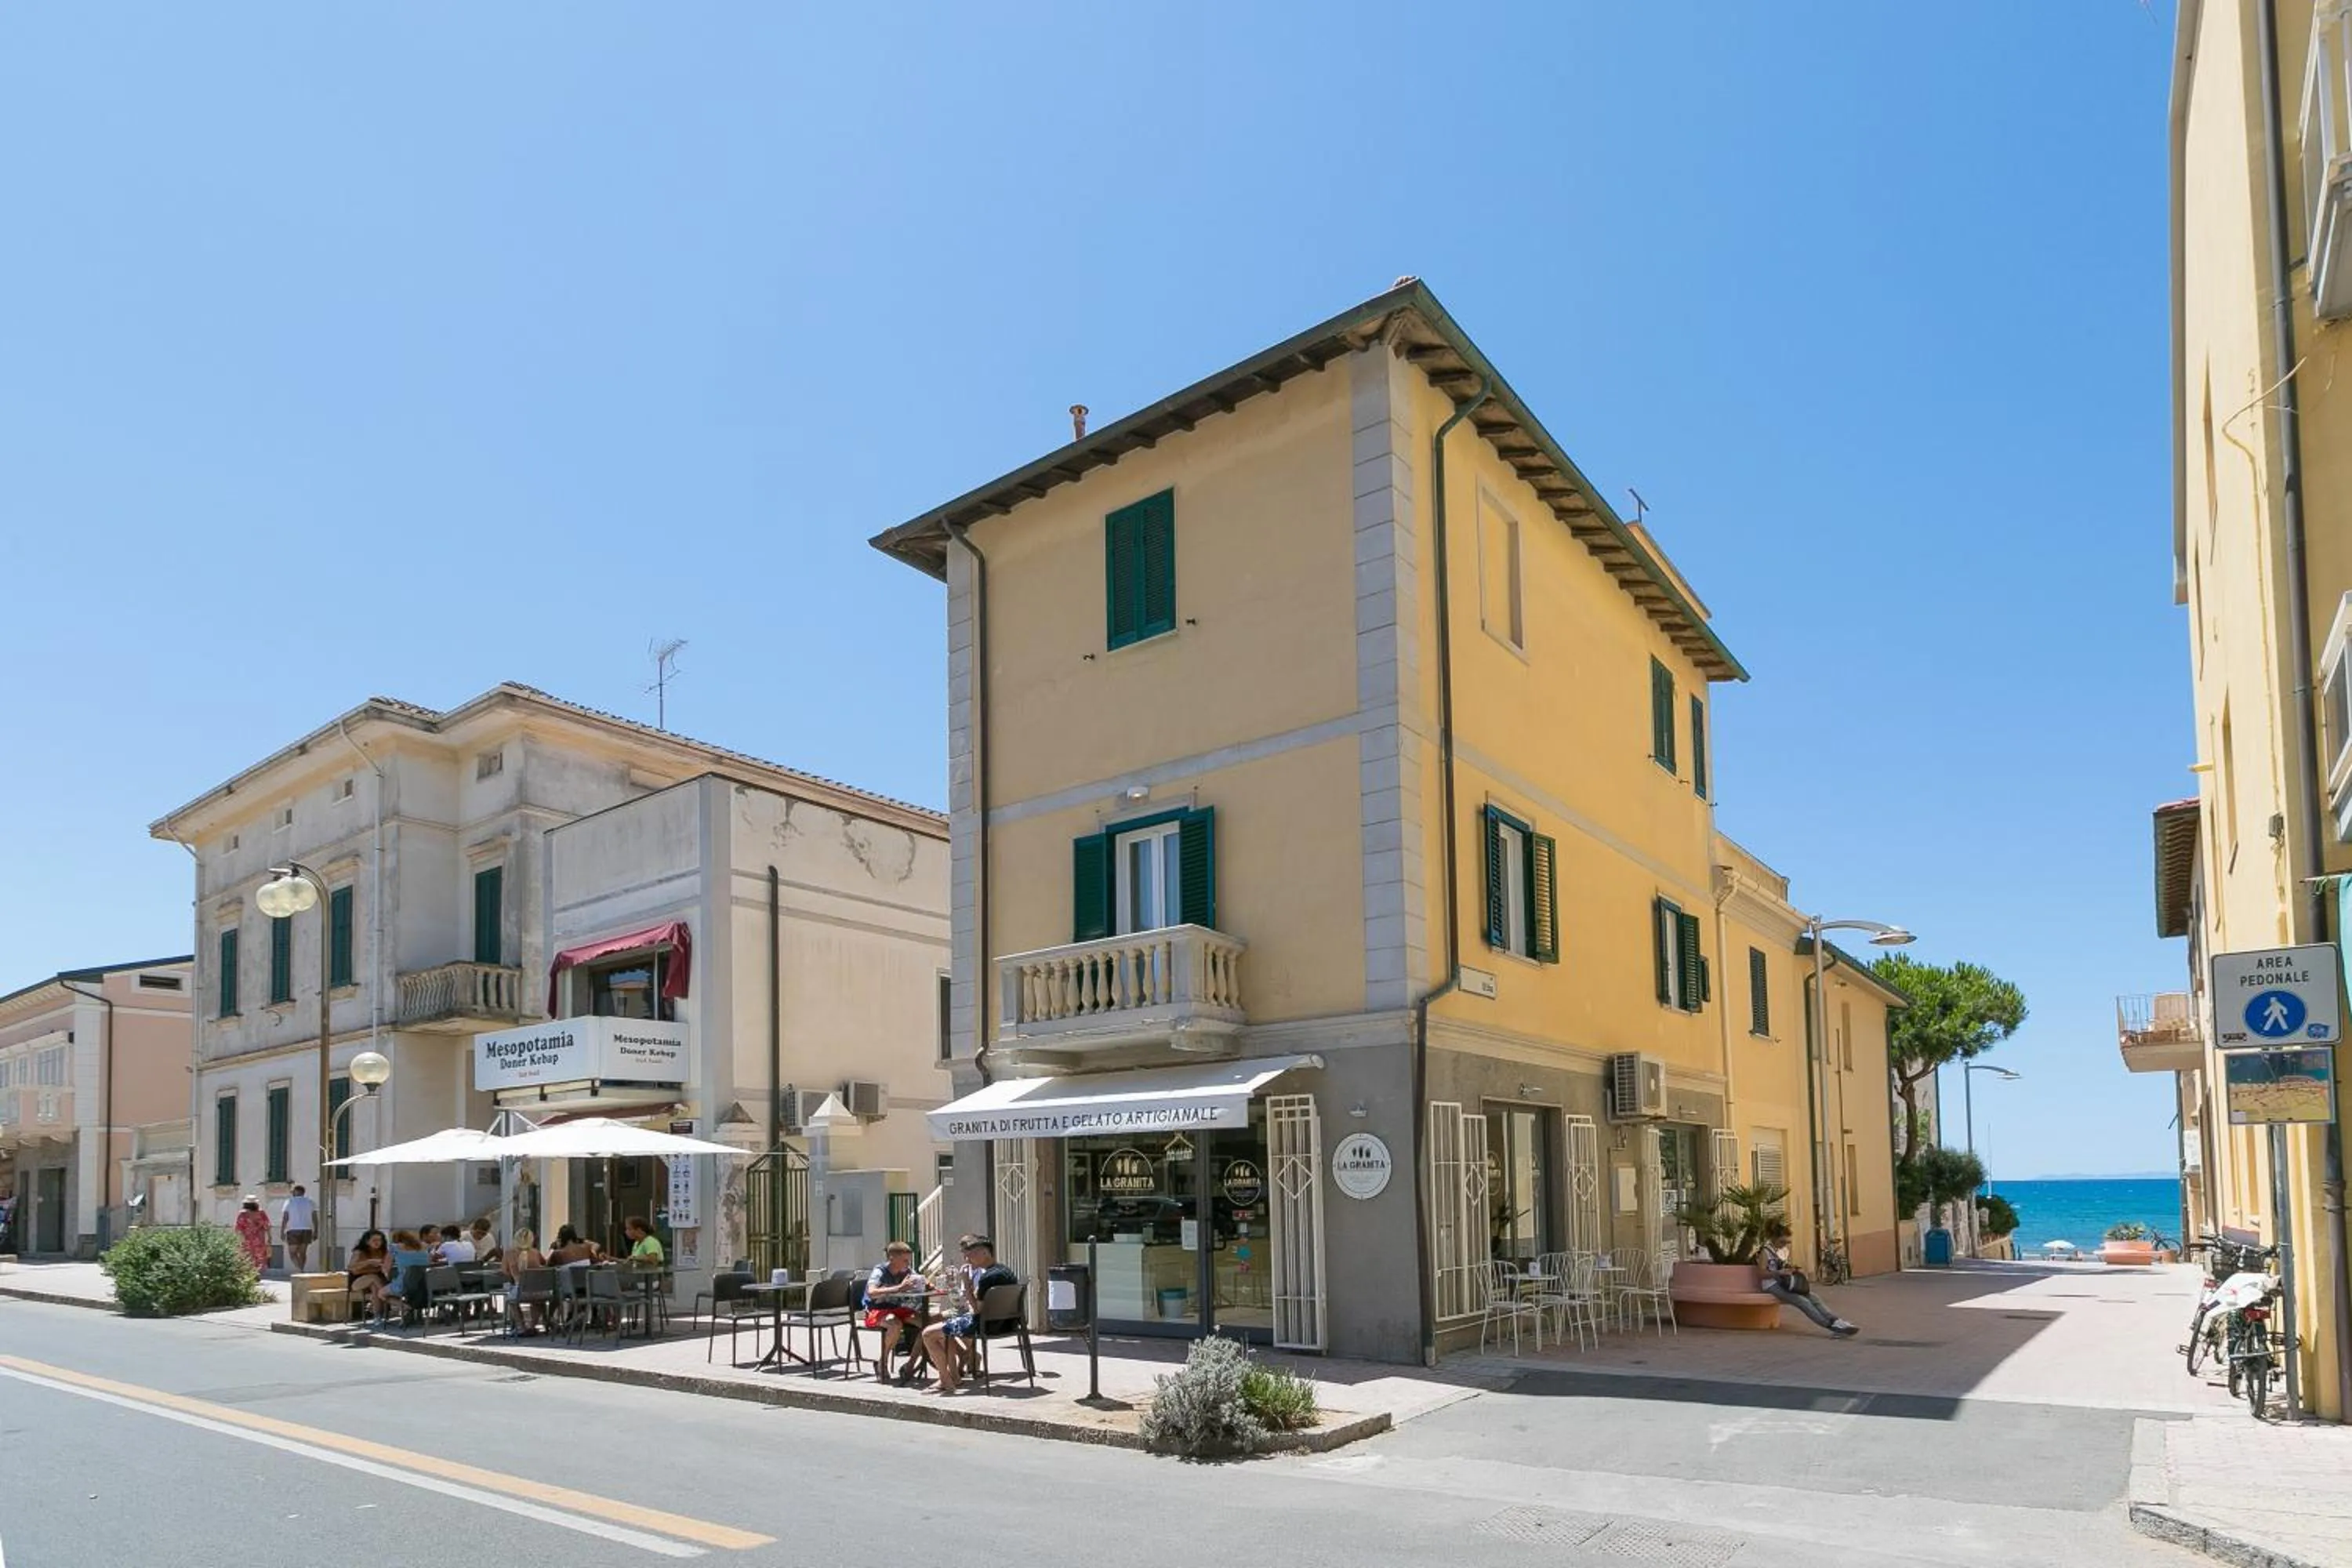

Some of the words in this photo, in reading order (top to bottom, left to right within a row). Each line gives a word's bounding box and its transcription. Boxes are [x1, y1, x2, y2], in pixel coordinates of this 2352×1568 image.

[2256, 956, 2293, 969] AREA
[2240, 971, 2310, 986] PEDONALE
[486, 1031, 574, 1058] Mesopotamia
[614, 1034, 681, 1046] Mesopotamia
[499, 1058, 527, 1069] Doner
[529, 1054, 559, 1066] Kebap
[949, 1120, 998, 1134] GRANITA
[1000, 1119, 1011, 1131] DI
[1012, 1116, 1058, 1131] FRUTTA
[1062, 1116, 1069, 1128] E
[1072, 1112, 1122, 1127] GELATO
[1125, 1107, 1218, 1125] ARTIGIANALE
[1349, 1160, 1385, 1169] GRANITA
[1100, 1177, 1112, 1188] LA
[1114, 1177, 1155, 1189] GRANITA
[1232, 1178, 1261, 1187] GRANITA
